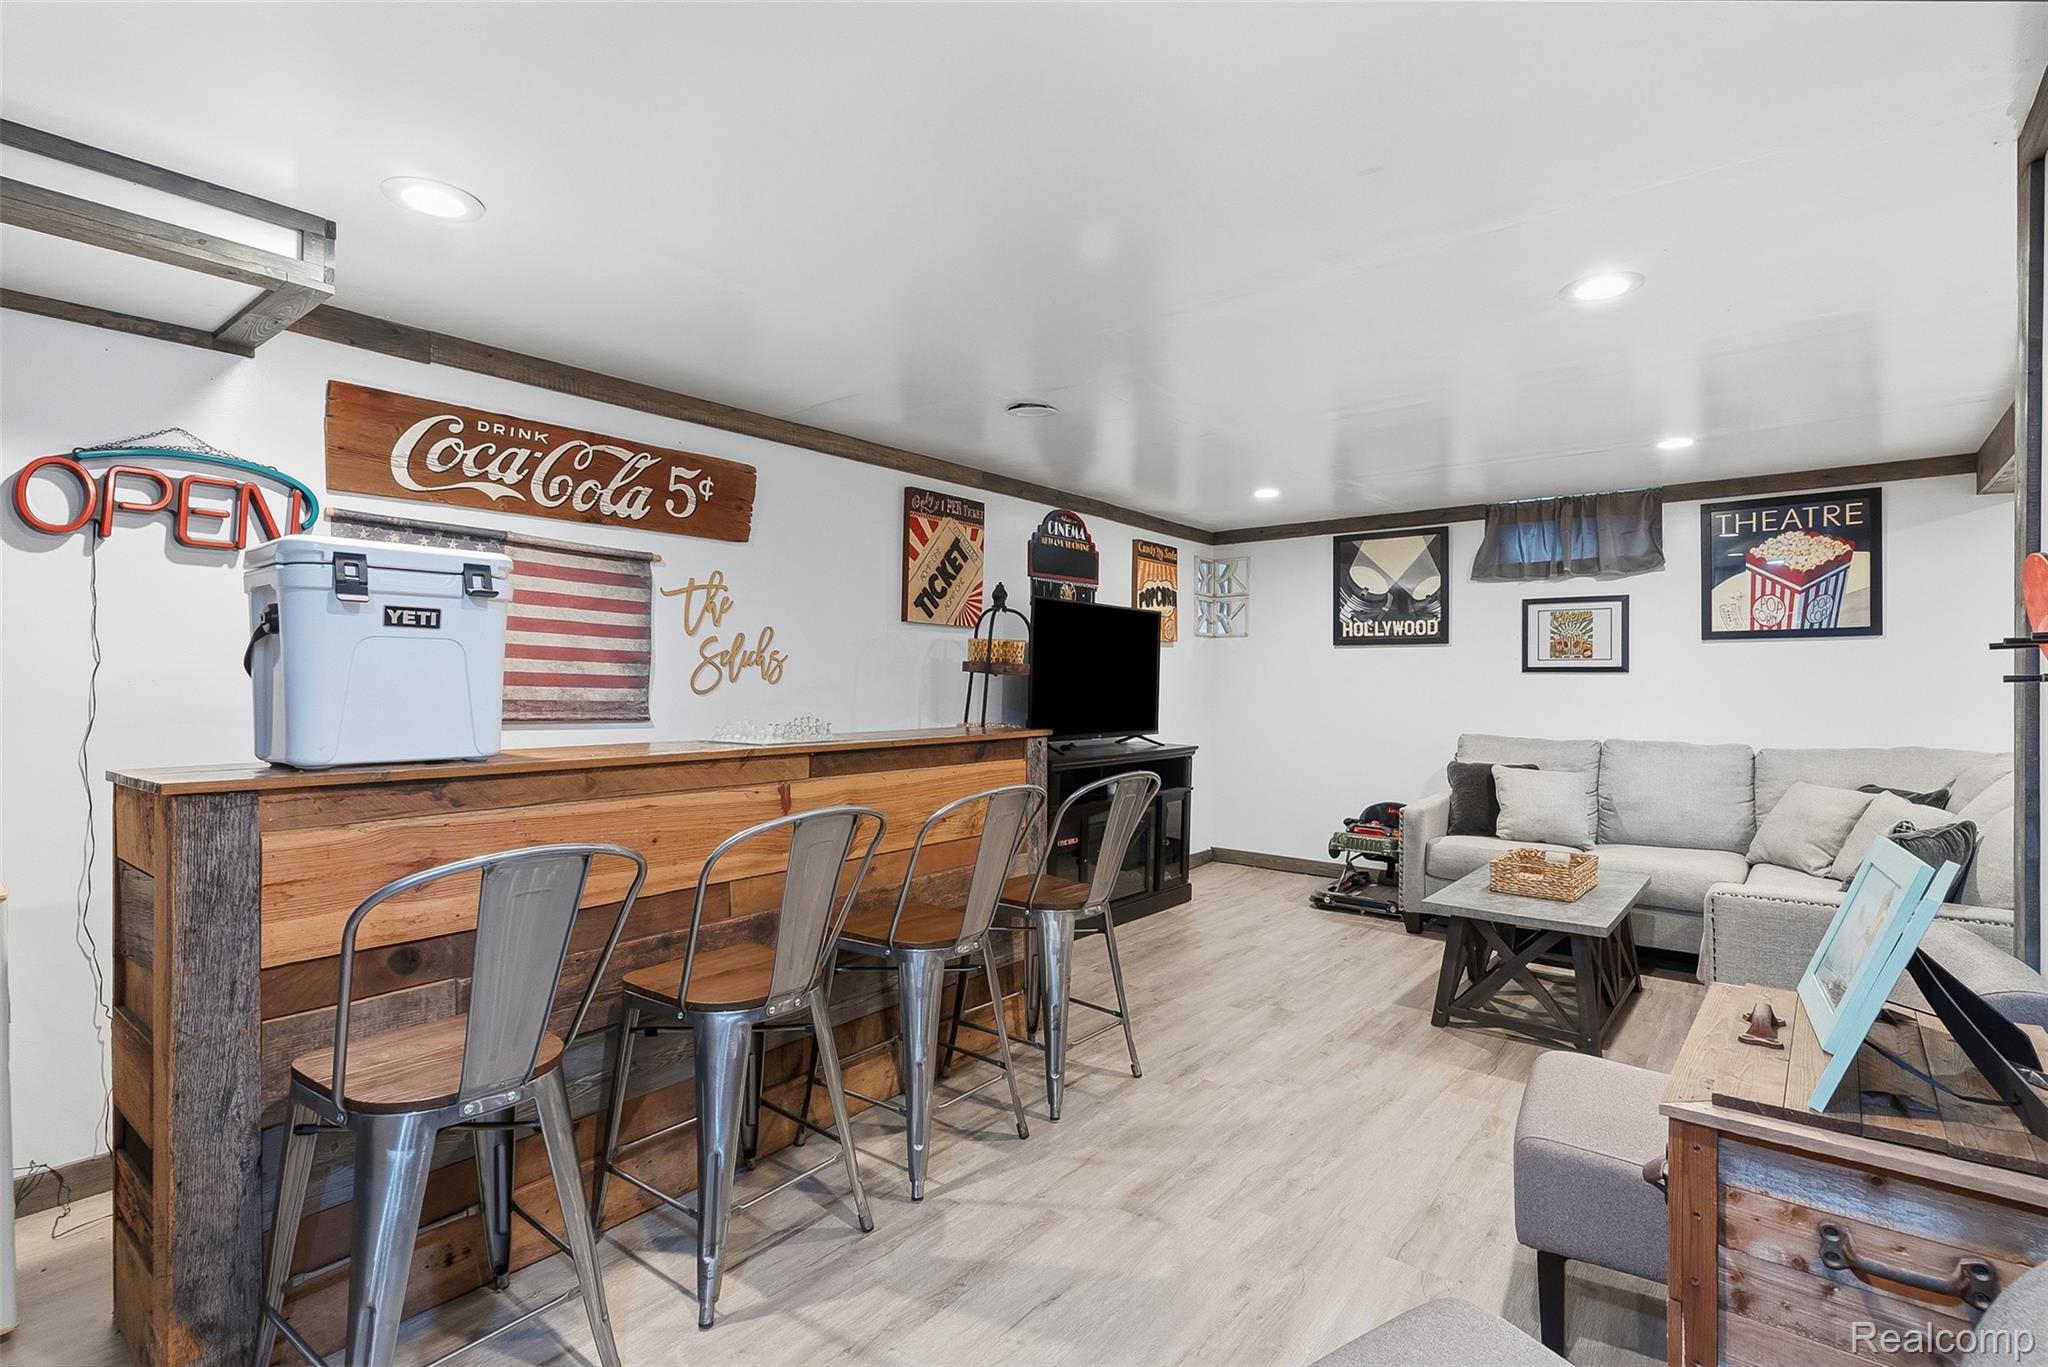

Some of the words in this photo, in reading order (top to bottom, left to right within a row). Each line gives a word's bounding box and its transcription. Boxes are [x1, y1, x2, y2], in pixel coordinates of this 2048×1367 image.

[477, 421, 549, 444] DRINK
[390, 414, 662, 520] Coca-Cola
[665, 466, 714, 518] 5¢
[15, 456, 302, 550] OPEN
[912, 491, 940, 514] Only
[946, 499, 962, 515] PER
[1048, 520, 1086, 540] CINEMA
[1715, 502, 1864, 536] THEATRE
[913, 537, 969, 619] TICKET
[1139, 586, 1177, 608] POPCORN
[1761, 597, 1783, 614] POP
[386, 608, 437, 626] YETI
[1754, 607, 1778, 624] CORN
[1342, 620, 1439, 637] HOLLYWOOD
